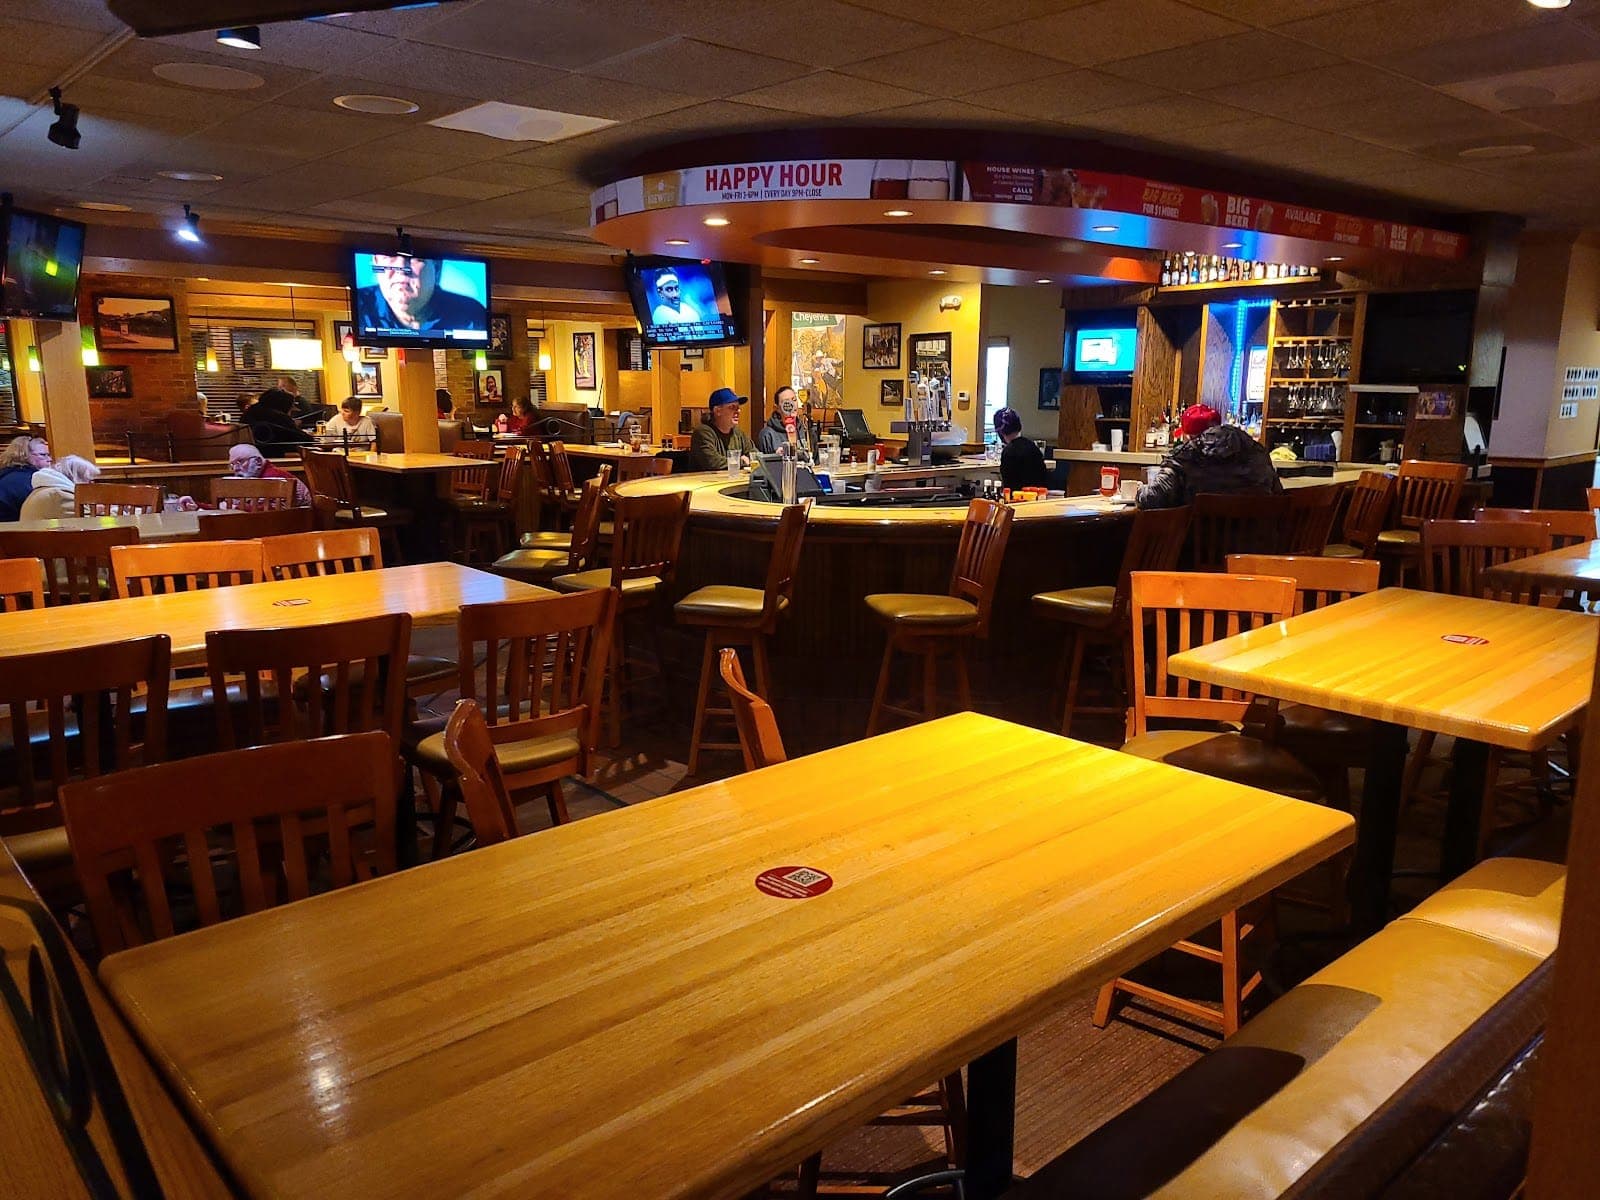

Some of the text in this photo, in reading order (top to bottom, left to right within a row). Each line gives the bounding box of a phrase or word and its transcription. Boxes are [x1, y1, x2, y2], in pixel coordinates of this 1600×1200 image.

[705, 163, 842, 192] HAPPY HOUR
[1226, 196, 1251, 216] BIG
[1225, 214, 1249, 229] BEER
[1285, 208, 1322, 225] AVAILABLE
[1391, 224, 1408, 241] BIG
[793, 313, 830, 324] Cheyenne
